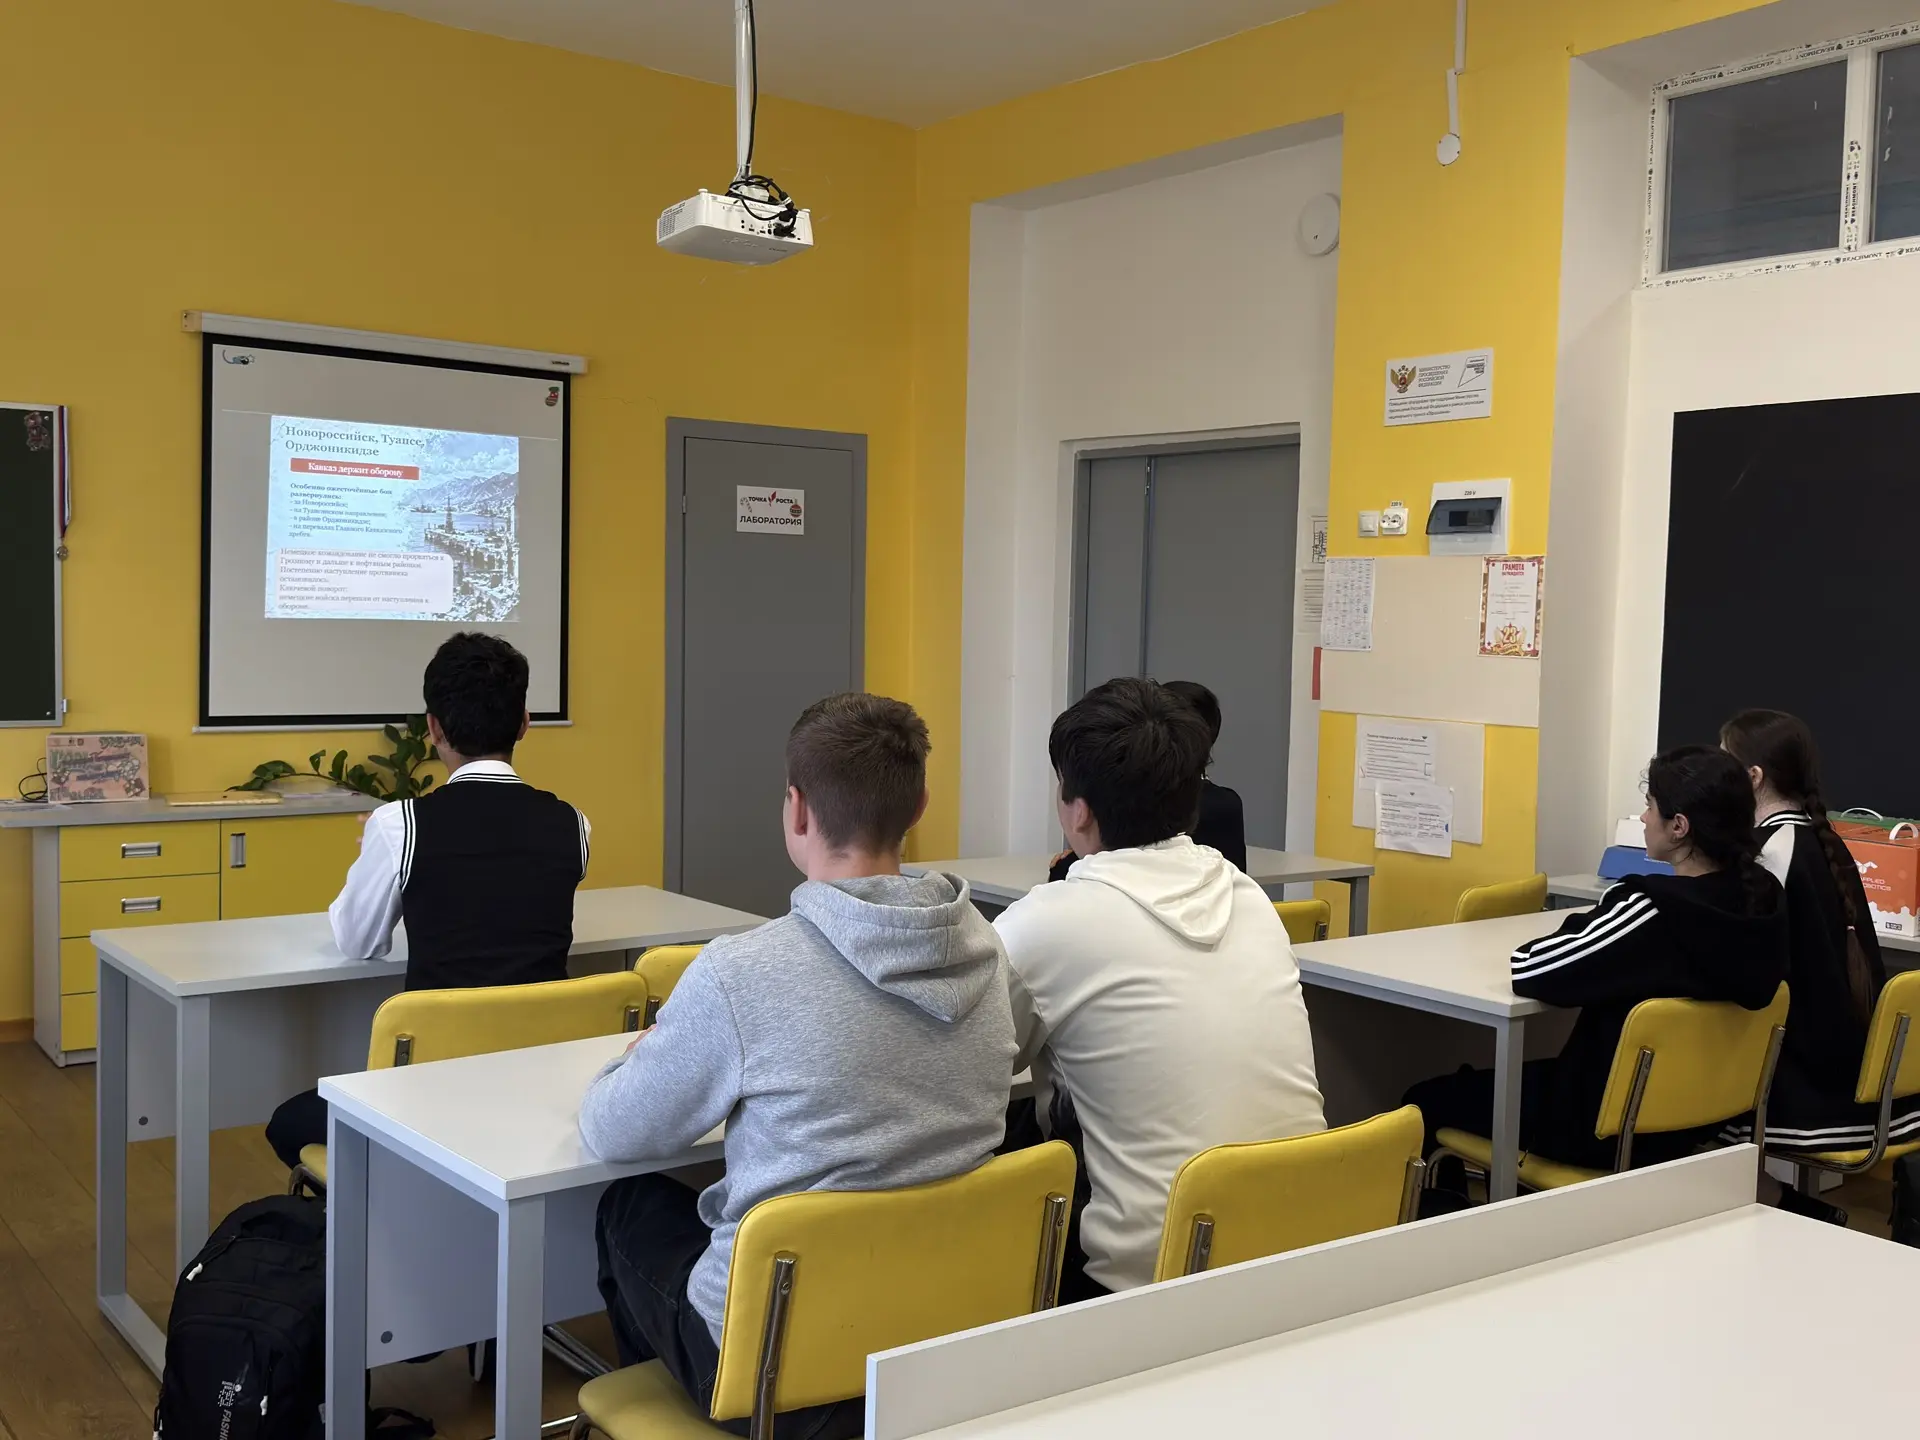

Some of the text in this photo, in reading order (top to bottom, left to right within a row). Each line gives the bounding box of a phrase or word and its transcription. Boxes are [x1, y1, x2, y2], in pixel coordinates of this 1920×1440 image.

[286, 426, 425, 448] Новороссийск, Туапсе,
[286, 440, 380, 456] Орджоникидзе
[308, 462, 403, 478] Кавказ держит оборону
[740, 516, 802, 525] ЛАБОРАТОРИЯ
[1503, 626, 1517, 644] 23
[220, 1409, 232, 1440] FASHI
